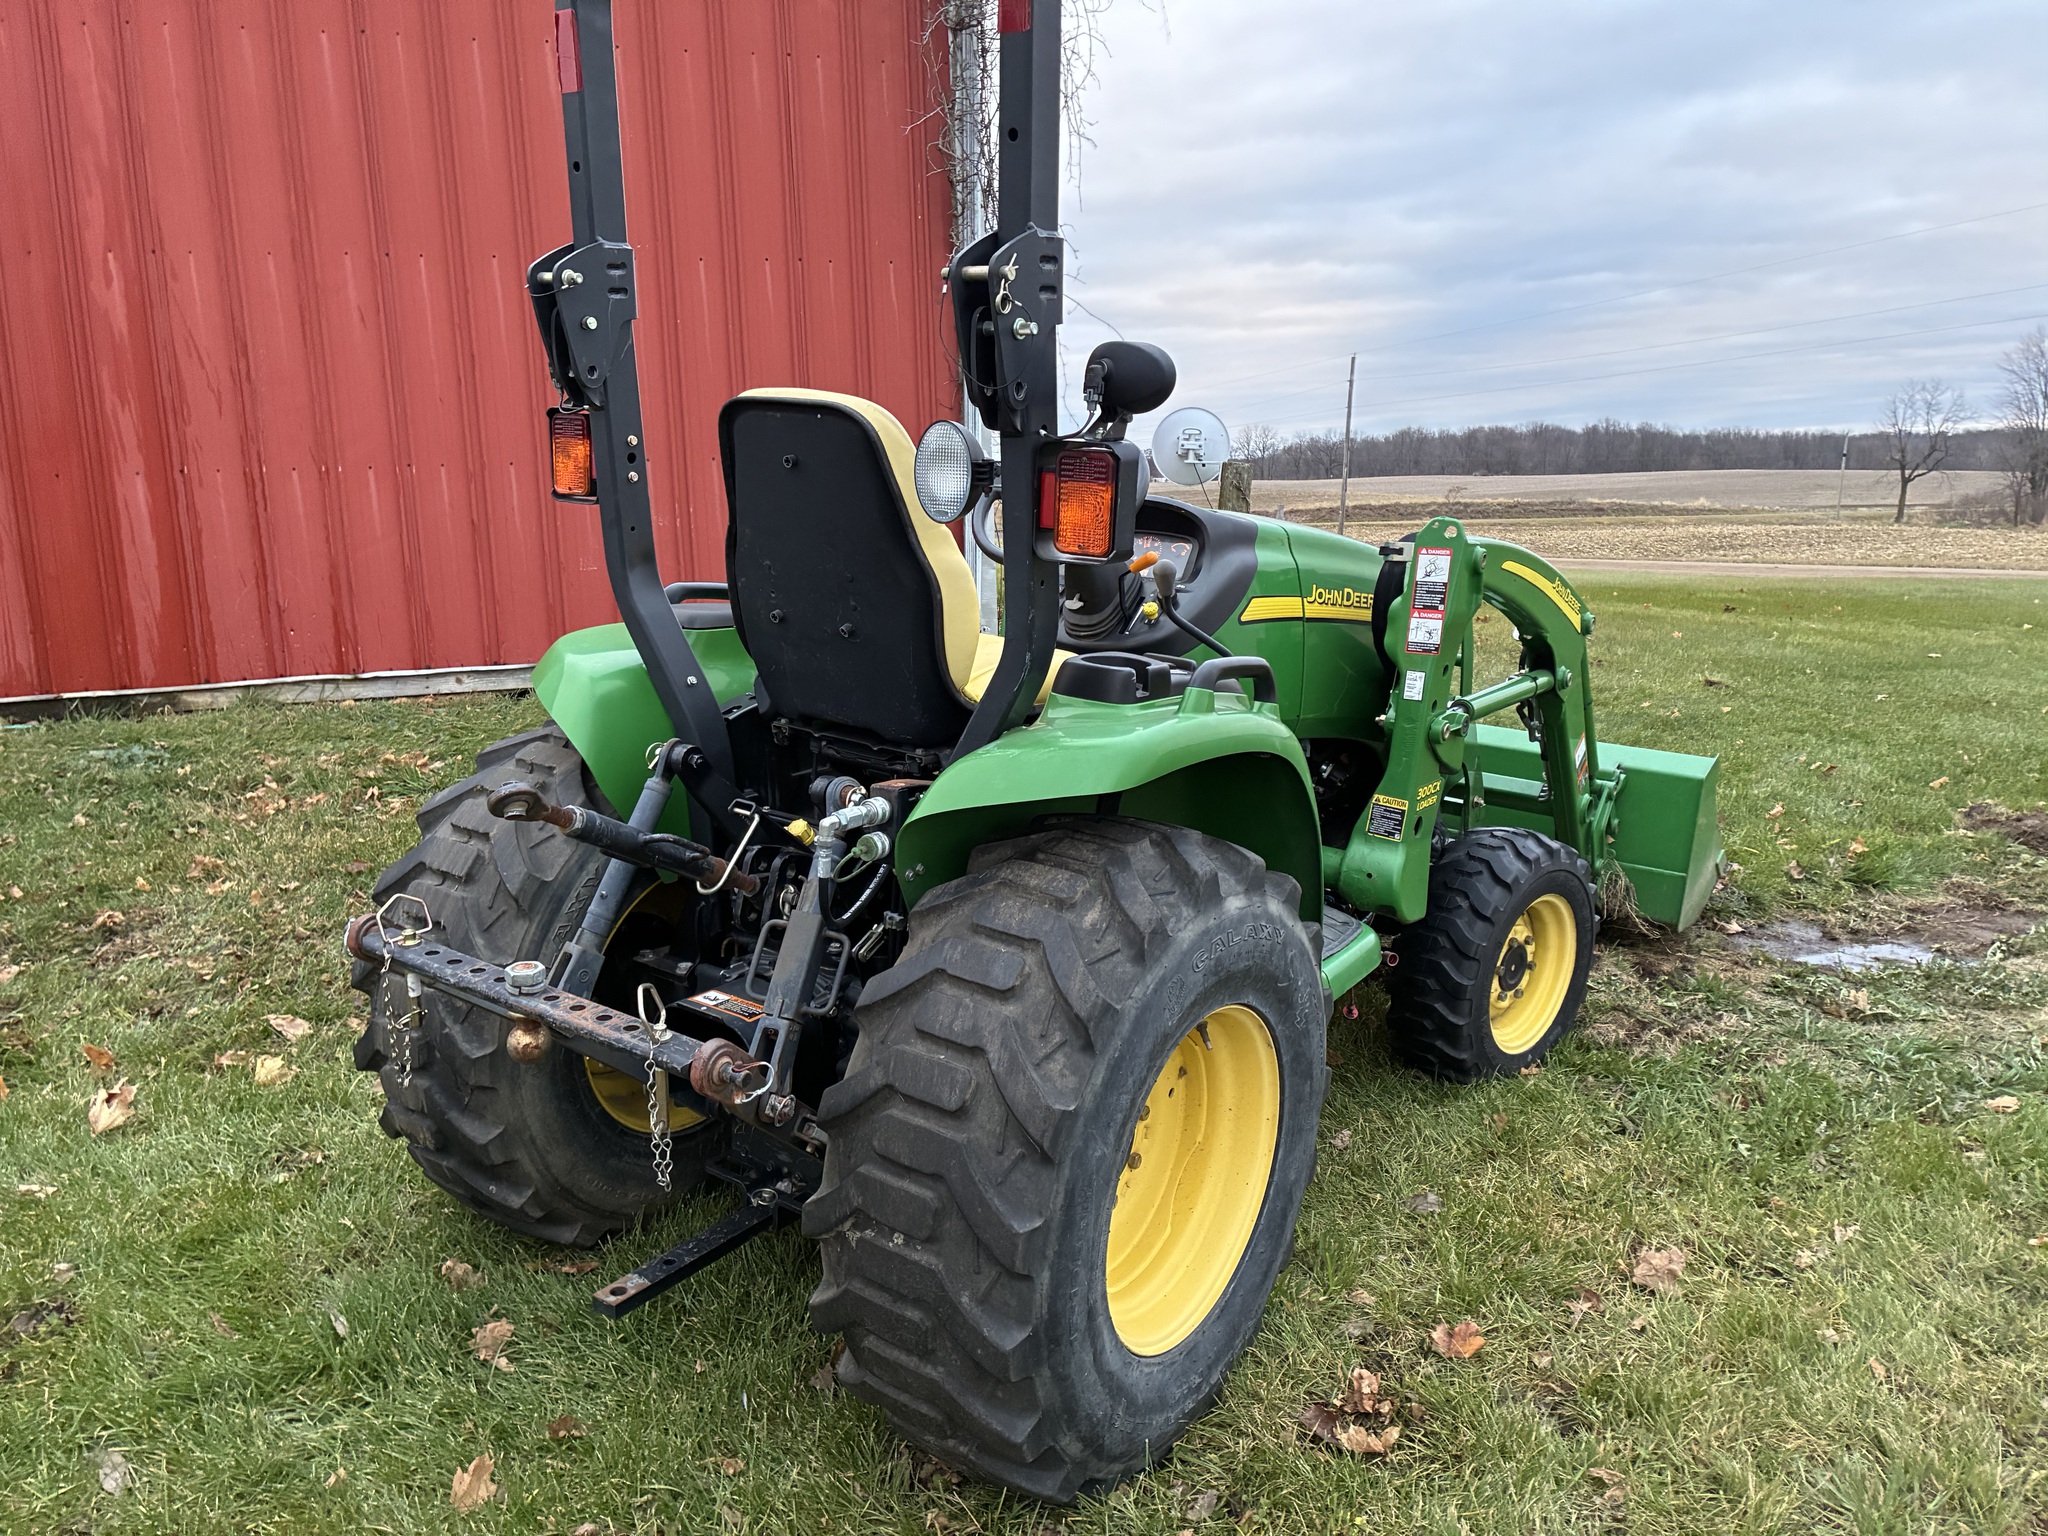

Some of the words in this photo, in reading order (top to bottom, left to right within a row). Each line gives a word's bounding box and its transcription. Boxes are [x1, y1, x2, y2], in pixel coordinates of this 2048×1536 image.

[1343, 587, 1375, 609] DEER
[1381, 796, 1408, 809] CAUTION
[1416, 795, 1438, 812] LOADER
[1192, 922, 1286, 973] GALAXY
